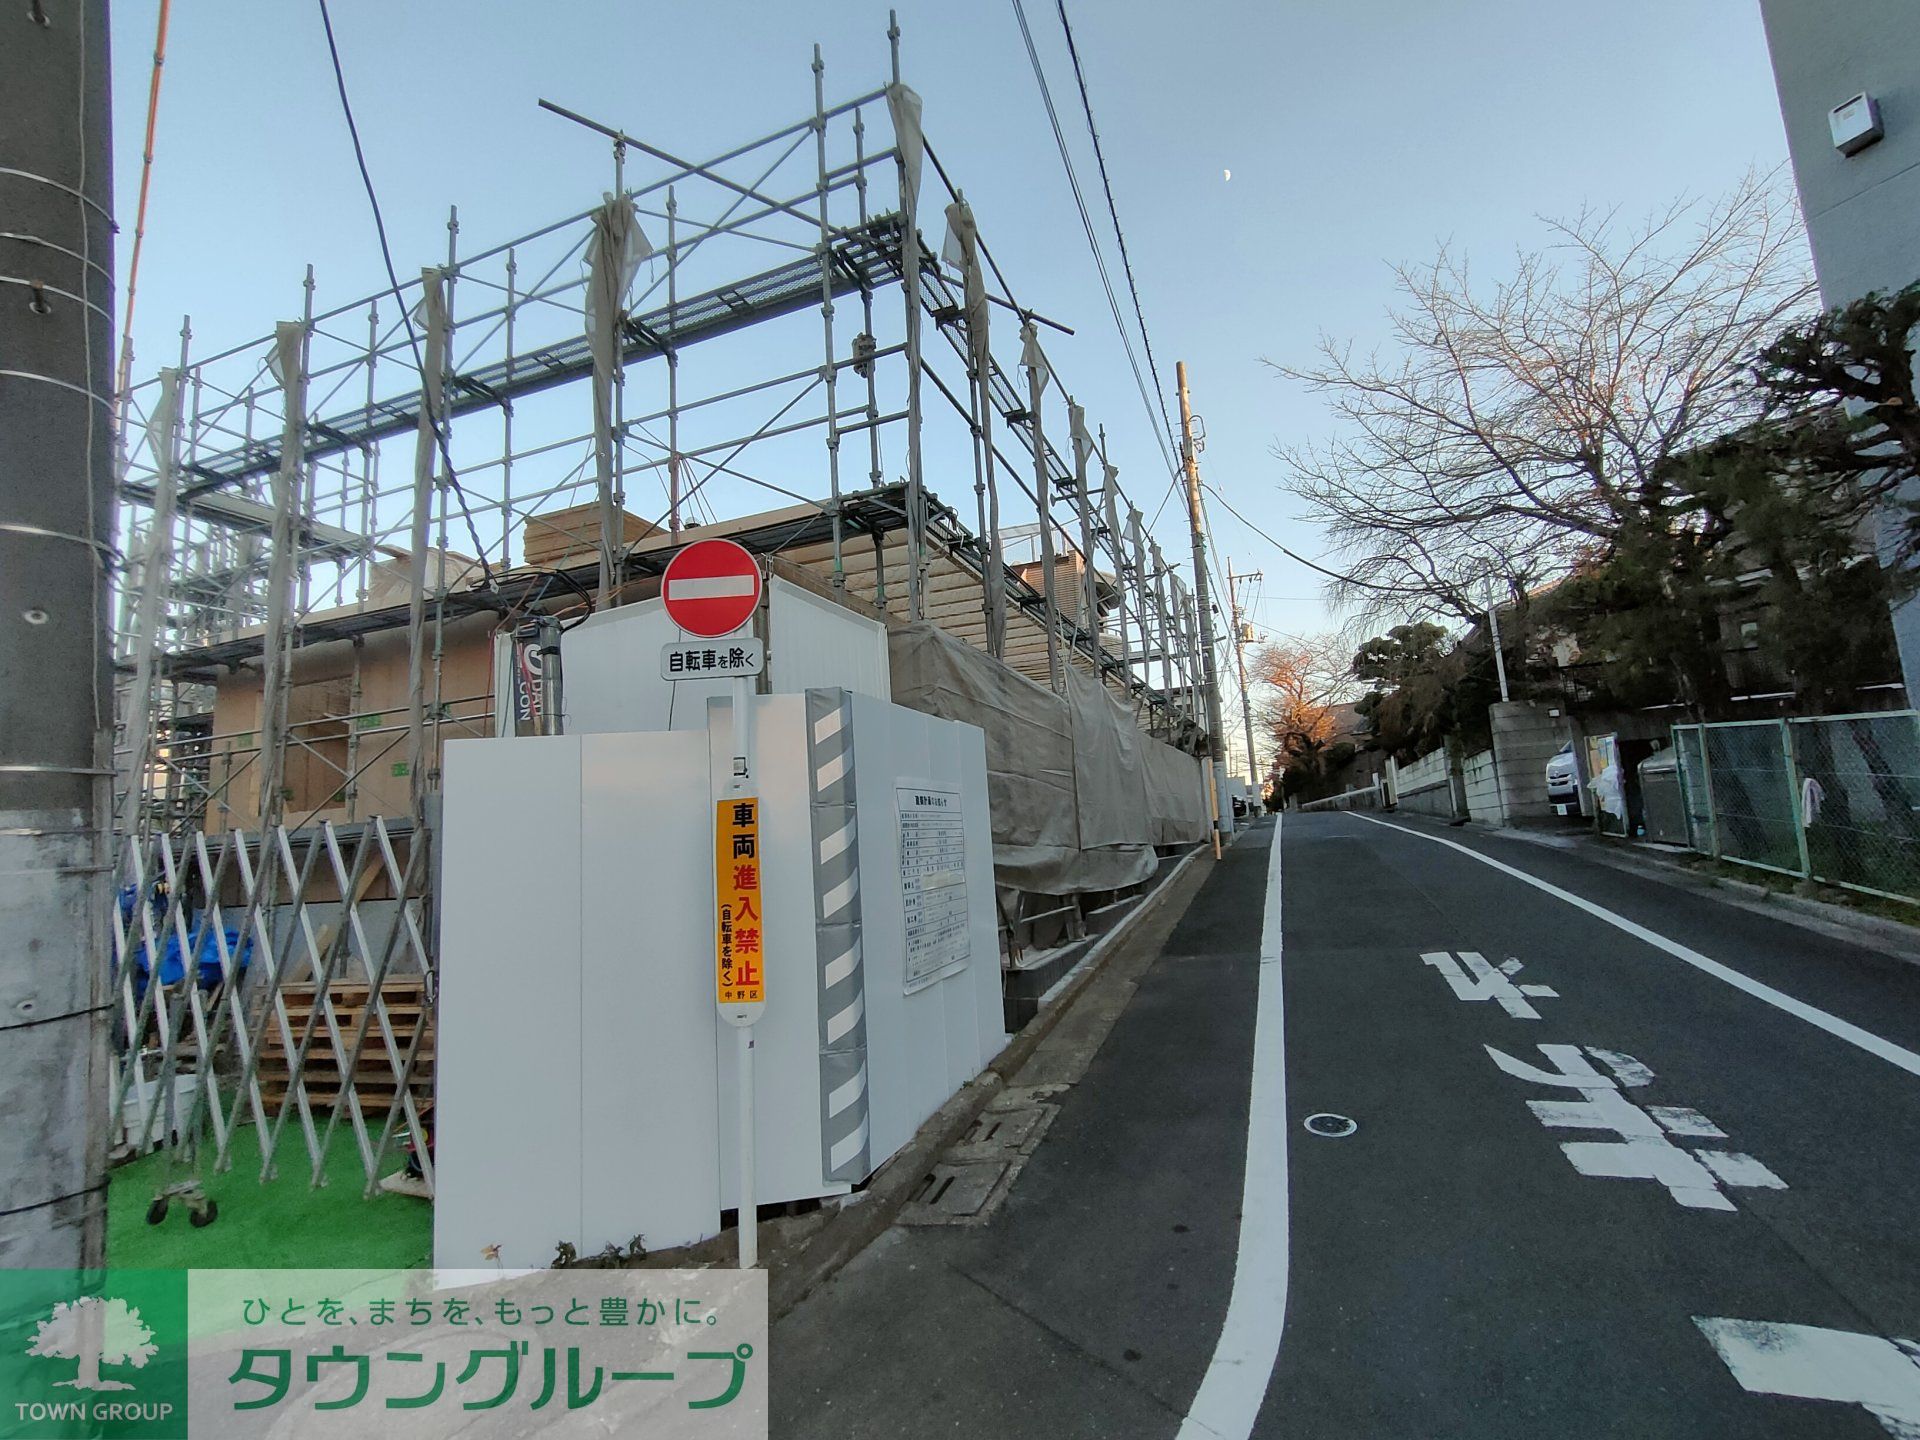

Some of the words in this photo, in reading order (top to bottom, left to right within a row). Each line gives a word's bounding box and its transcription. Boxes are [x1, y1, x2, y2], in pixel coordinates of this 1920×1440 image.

[669, 647, 754, 672] 自転車を除く
[732, 802, 760, 986] 車両進入禁止
[724, 990, 758, 1000] 中野区
